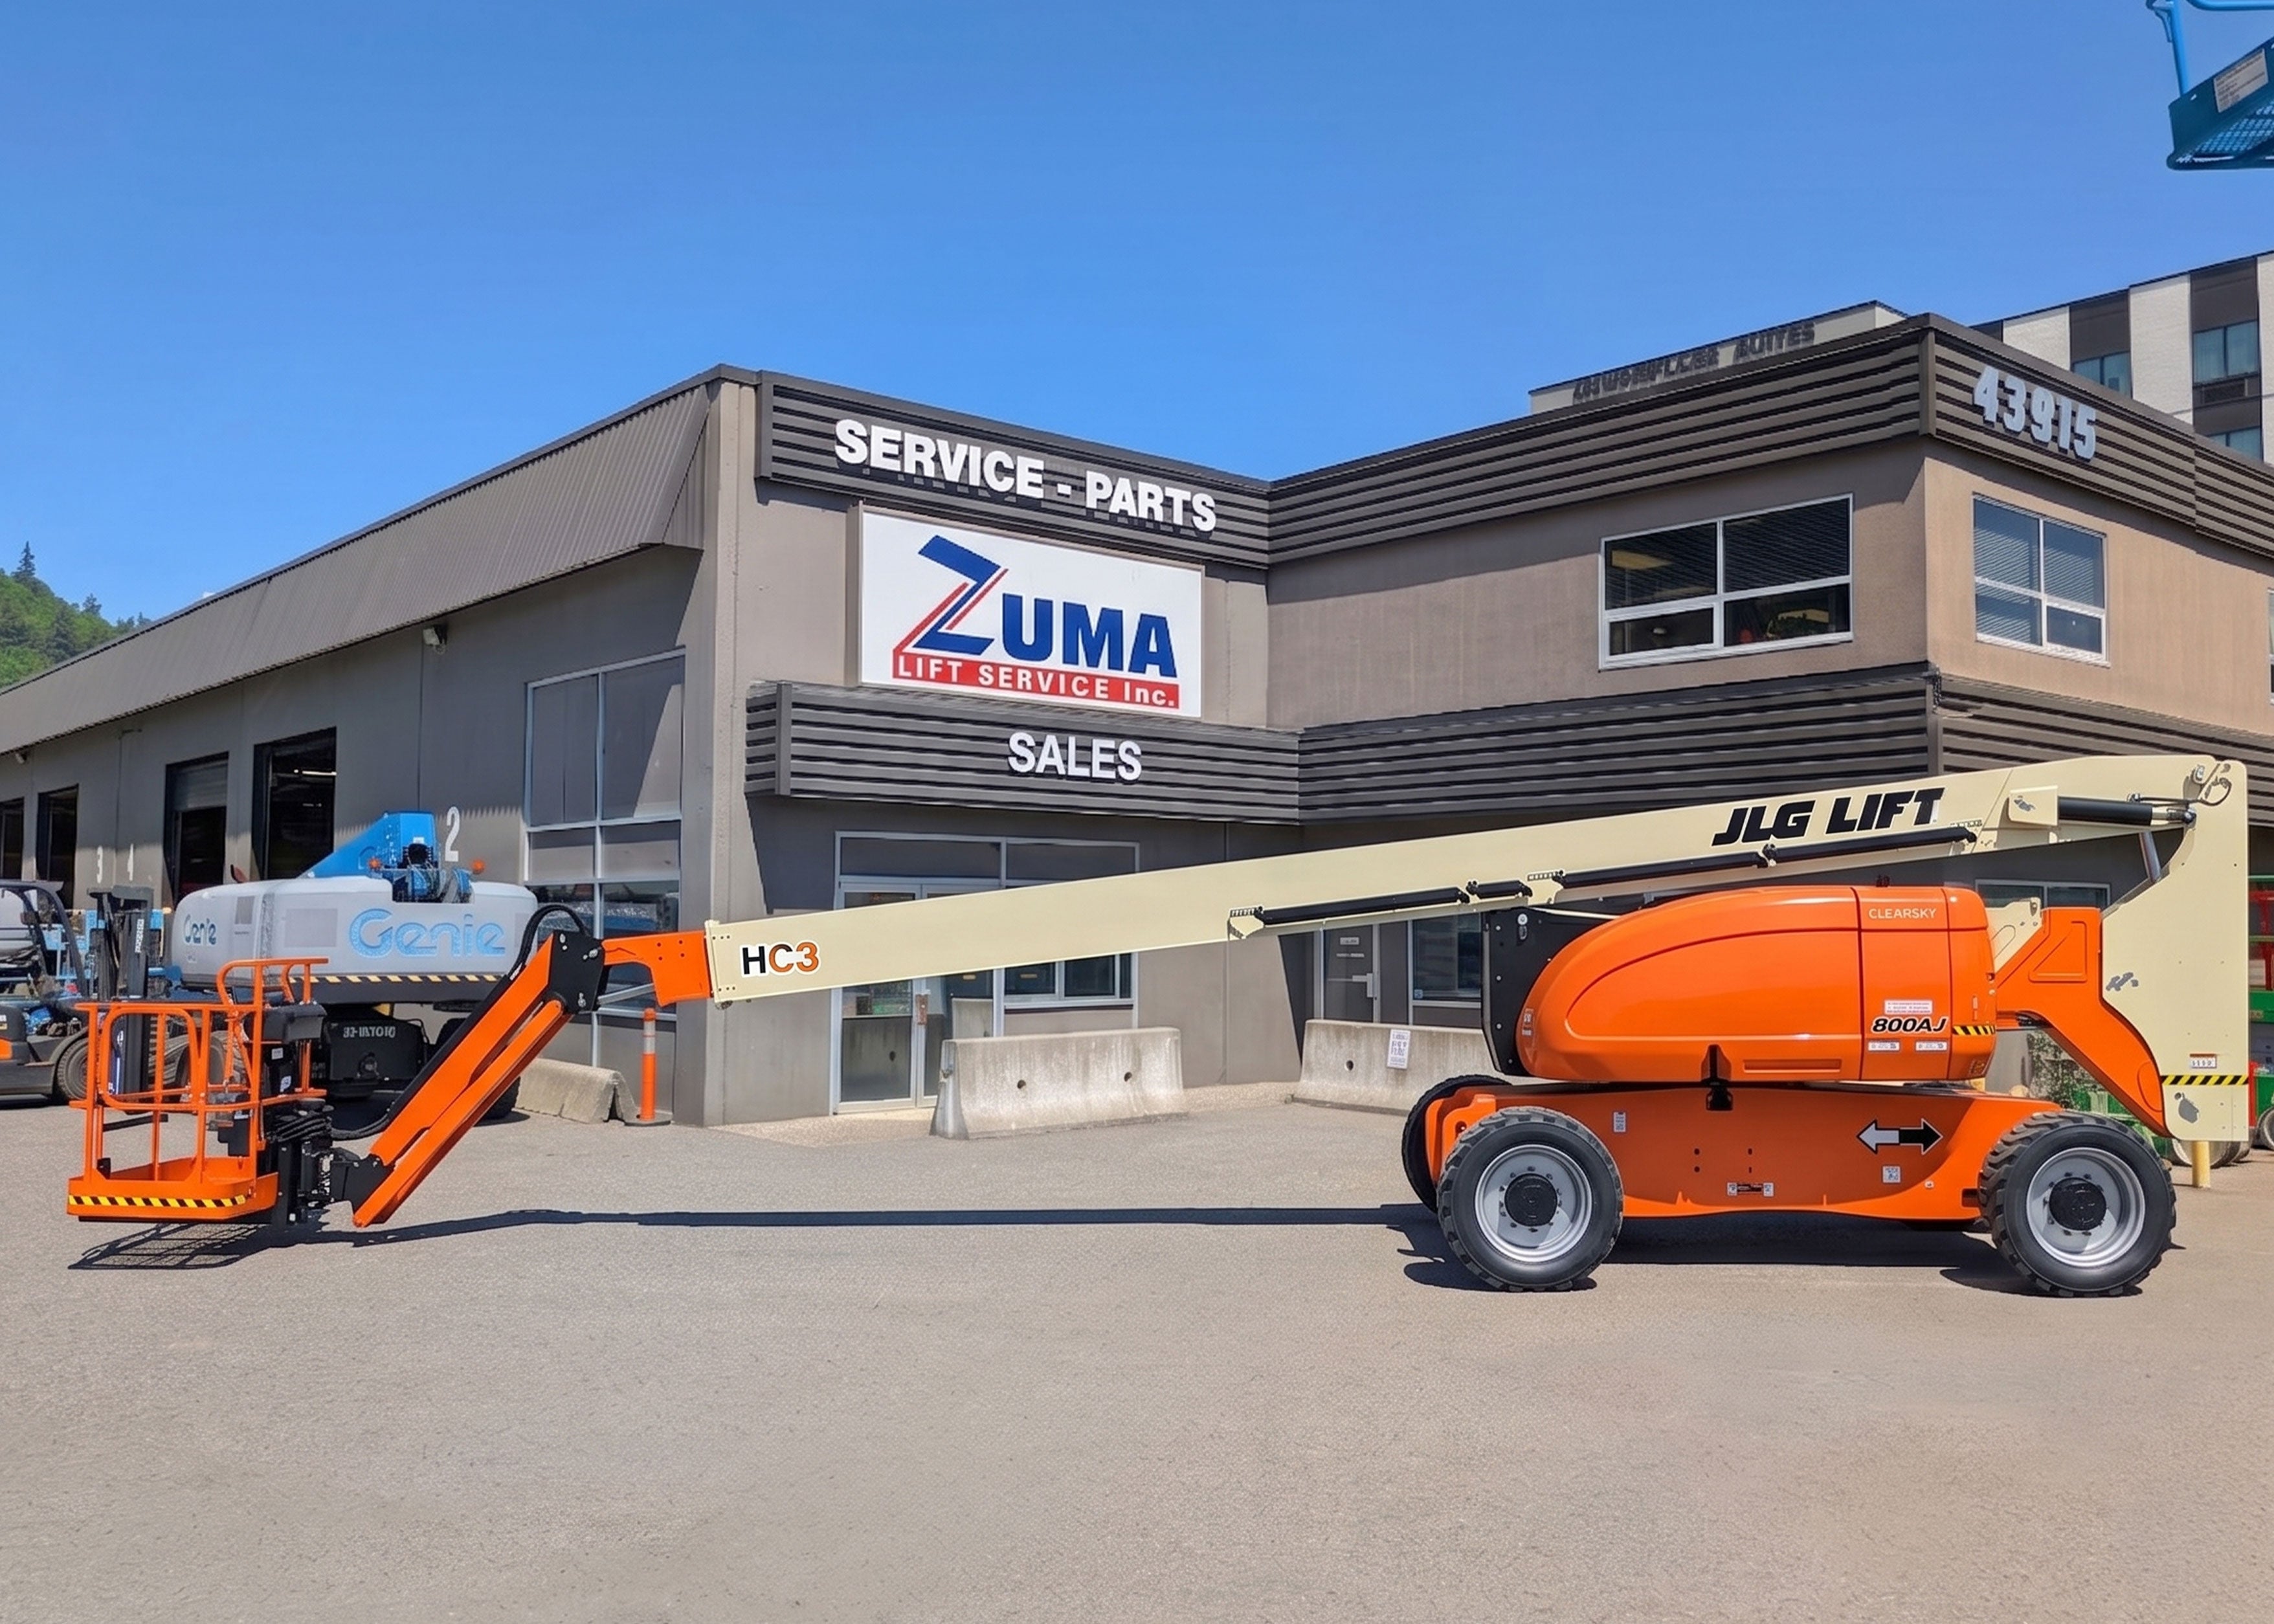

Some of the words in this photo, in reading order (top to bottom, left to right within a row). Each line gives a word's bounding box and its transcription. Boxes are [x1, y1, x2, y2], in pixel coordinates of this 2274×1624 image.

[1973, 366, 2096, 461] 43915
[835, 419, 1044, 498] SERVICE
[1086, 471, 1216, 533] PARTS
[897, 535, 1177, 678] ZUMA
[898, 656, 961, 682] LIFT
[979, 666, 1109, 700] SERVICE
[1124, 682, 1174, 707] Inc.
[1008, 733, 1142, 781] SALES
[445, 806, 460, 862] 2
[1711, 800, 1815, 846] JLG
[1825, 788, 1945, 834] LIFT
[349, 908, 506, 957] Genie
[1868, 908, 1937, 919] CLEARSKY
[742, 942, 819, 975] HC3
[1872, 1018, 1947, 1032] 800AJ
